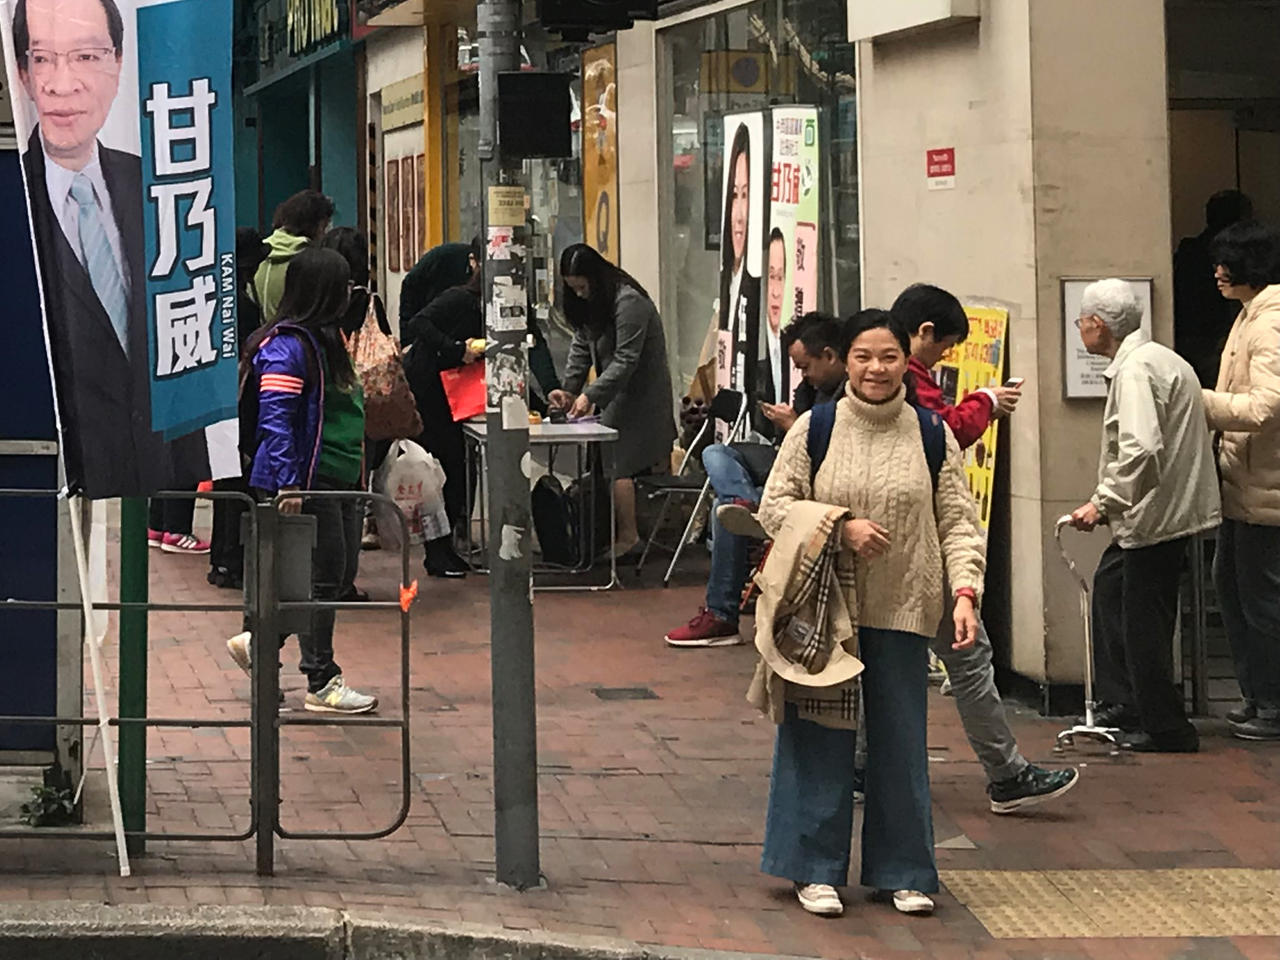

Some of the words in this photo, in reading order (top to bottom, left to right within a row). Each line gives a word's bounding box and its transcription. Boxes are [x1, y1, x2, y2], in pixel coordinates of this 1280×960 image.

[146, 78, 218, 377] 甘乃威
[221, 253, 235, 292] KAM
[221, 295, 235, 324] Nai
[222, 326, 237, 359] Wai
